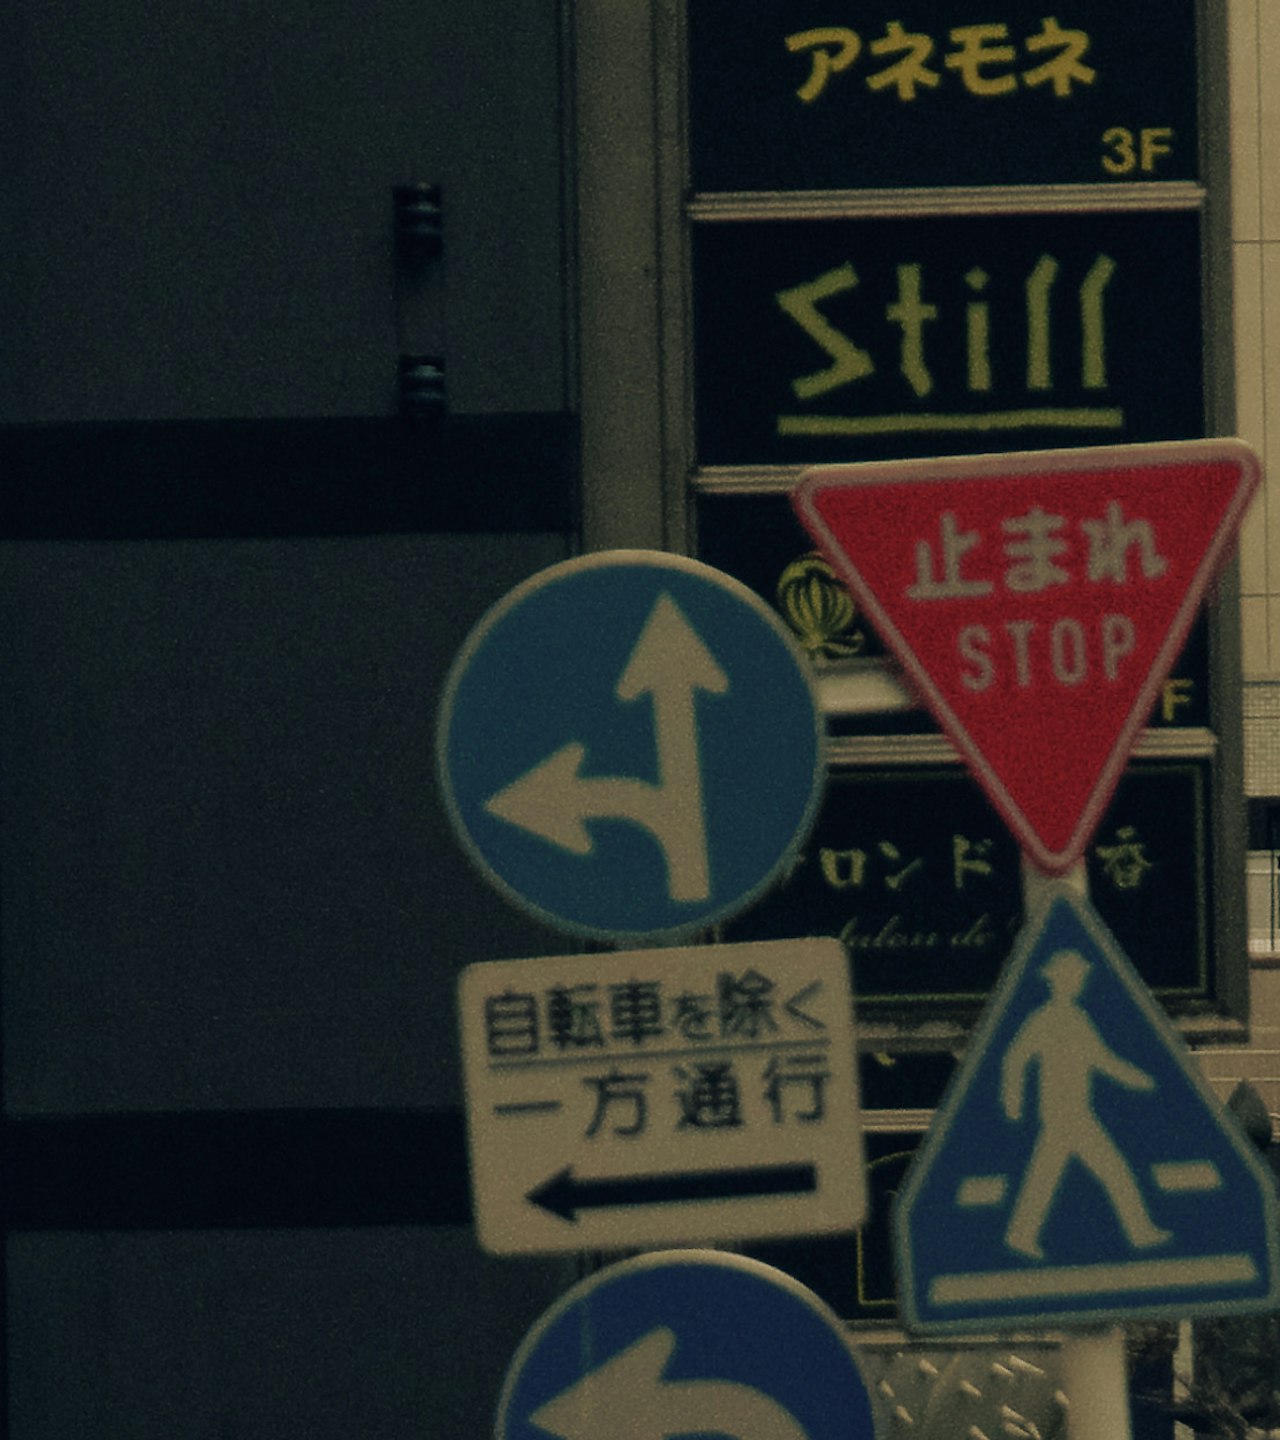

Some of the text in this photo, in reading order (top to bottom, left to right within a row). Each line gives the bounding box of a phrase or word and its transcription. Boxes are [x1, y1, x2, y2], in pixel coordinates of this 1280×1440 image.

[784, 16, 1098, 101] アネモネ
[1100, 127, 1175, 174] 3F
[775, 252, 1116, 399] Still
[904, 500, 1171, 604] 止まれ
[957, 612, 1136, 691] STOP
[1160, 677, 1195, 722] F
[485, 969, 826, 1056] 自転車を除く
[494, 1053, 830, 1139] 一方通行
